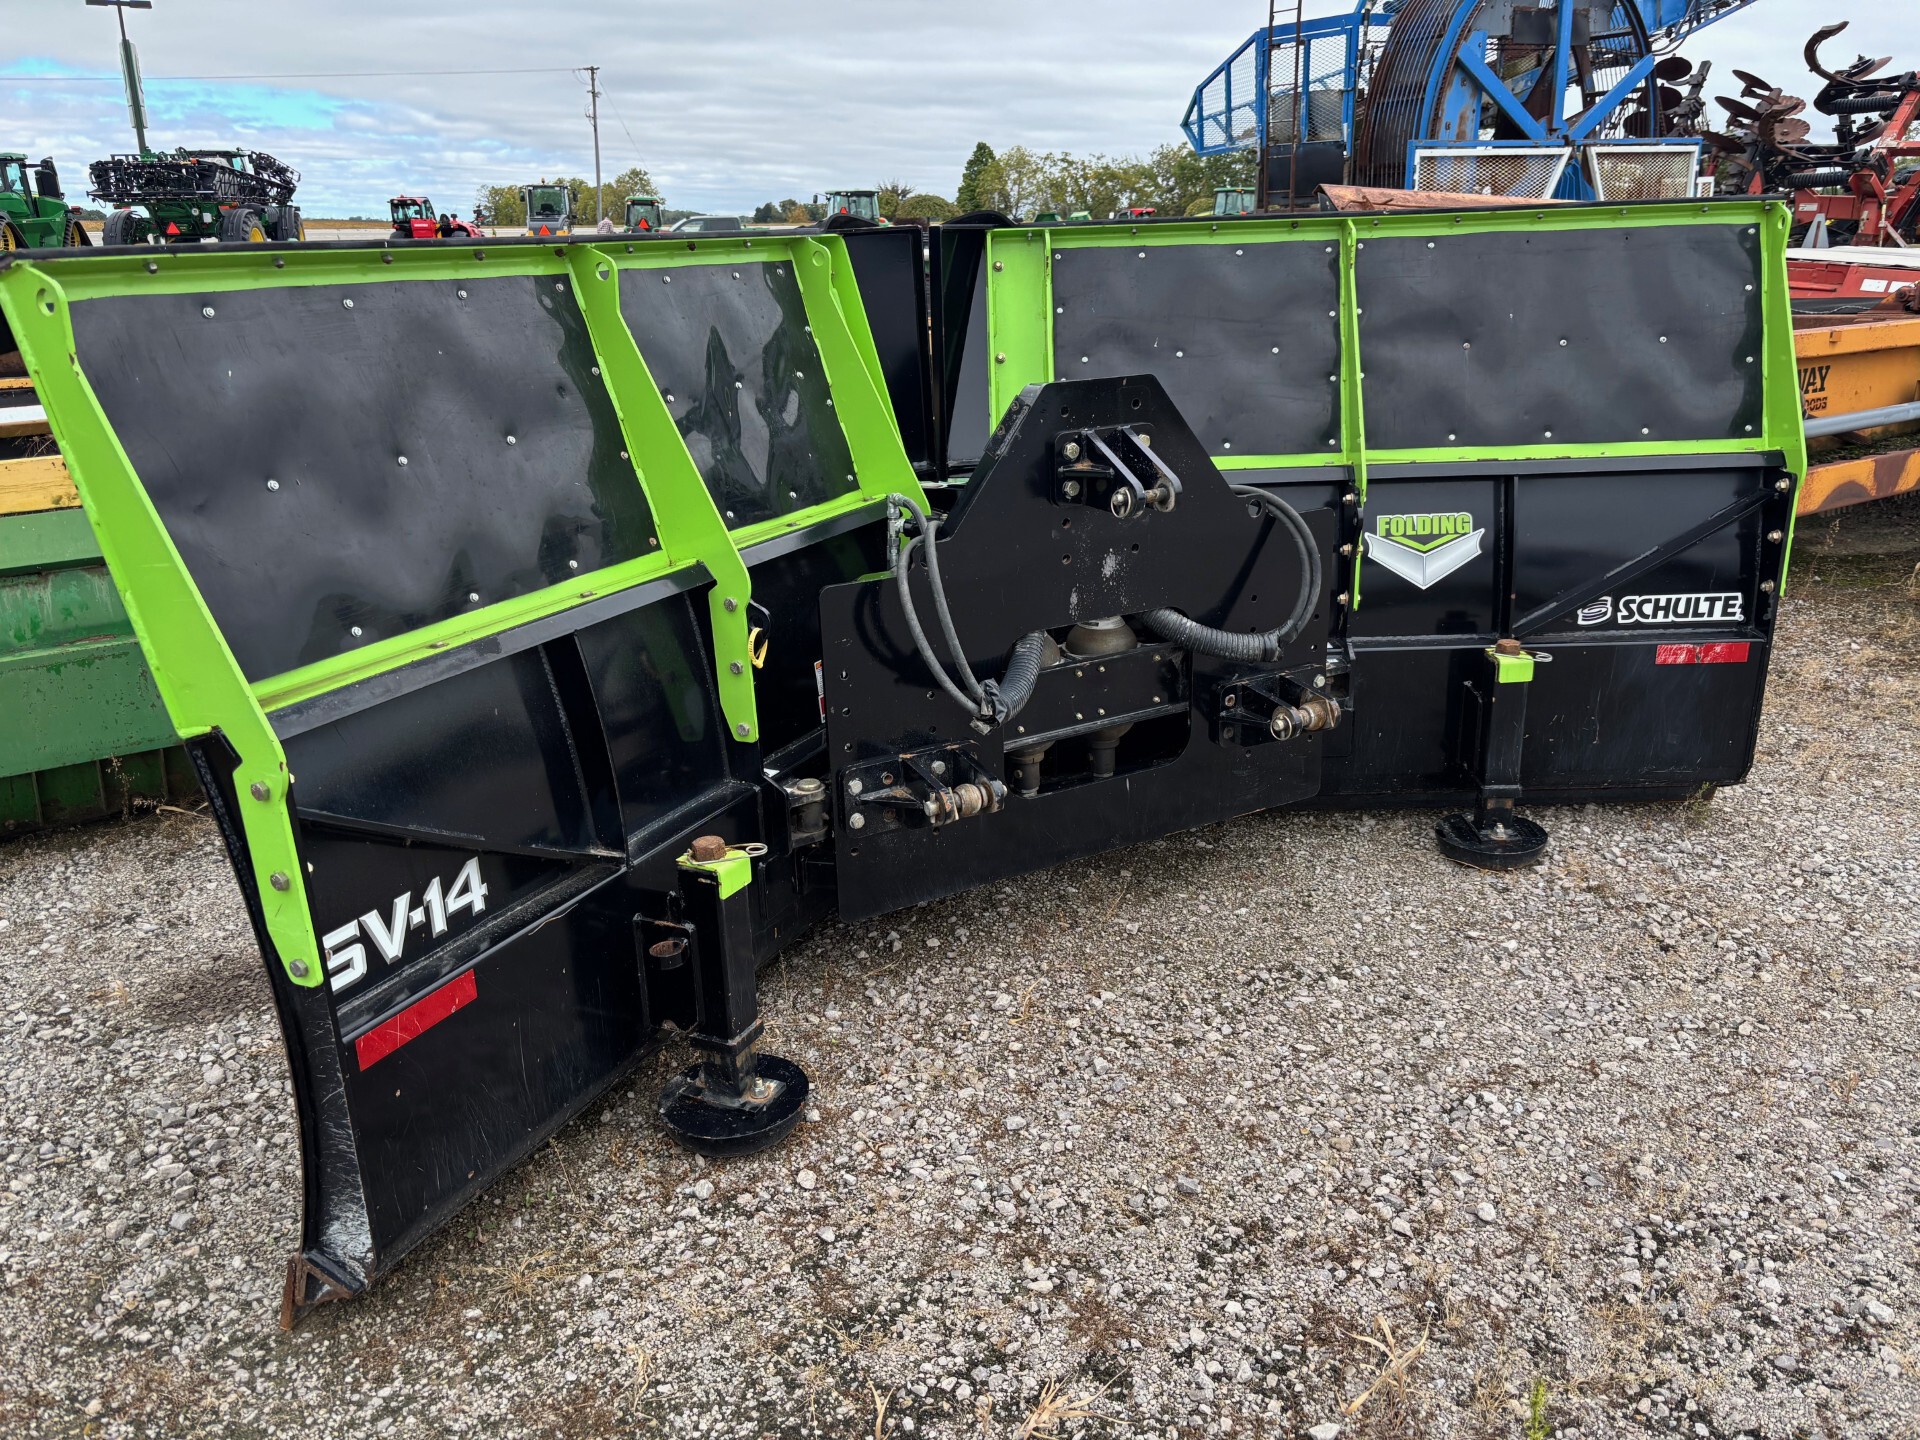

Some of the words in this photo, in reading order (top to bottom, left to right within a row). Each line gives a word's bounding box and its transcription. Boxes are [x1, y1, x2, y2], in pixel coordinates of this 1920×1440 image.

[1379, 514, 1471, 537] FOLDING
[1620, 595, 1739, 621] SCHULTE
[322, 856, 488, 995] SV-14
